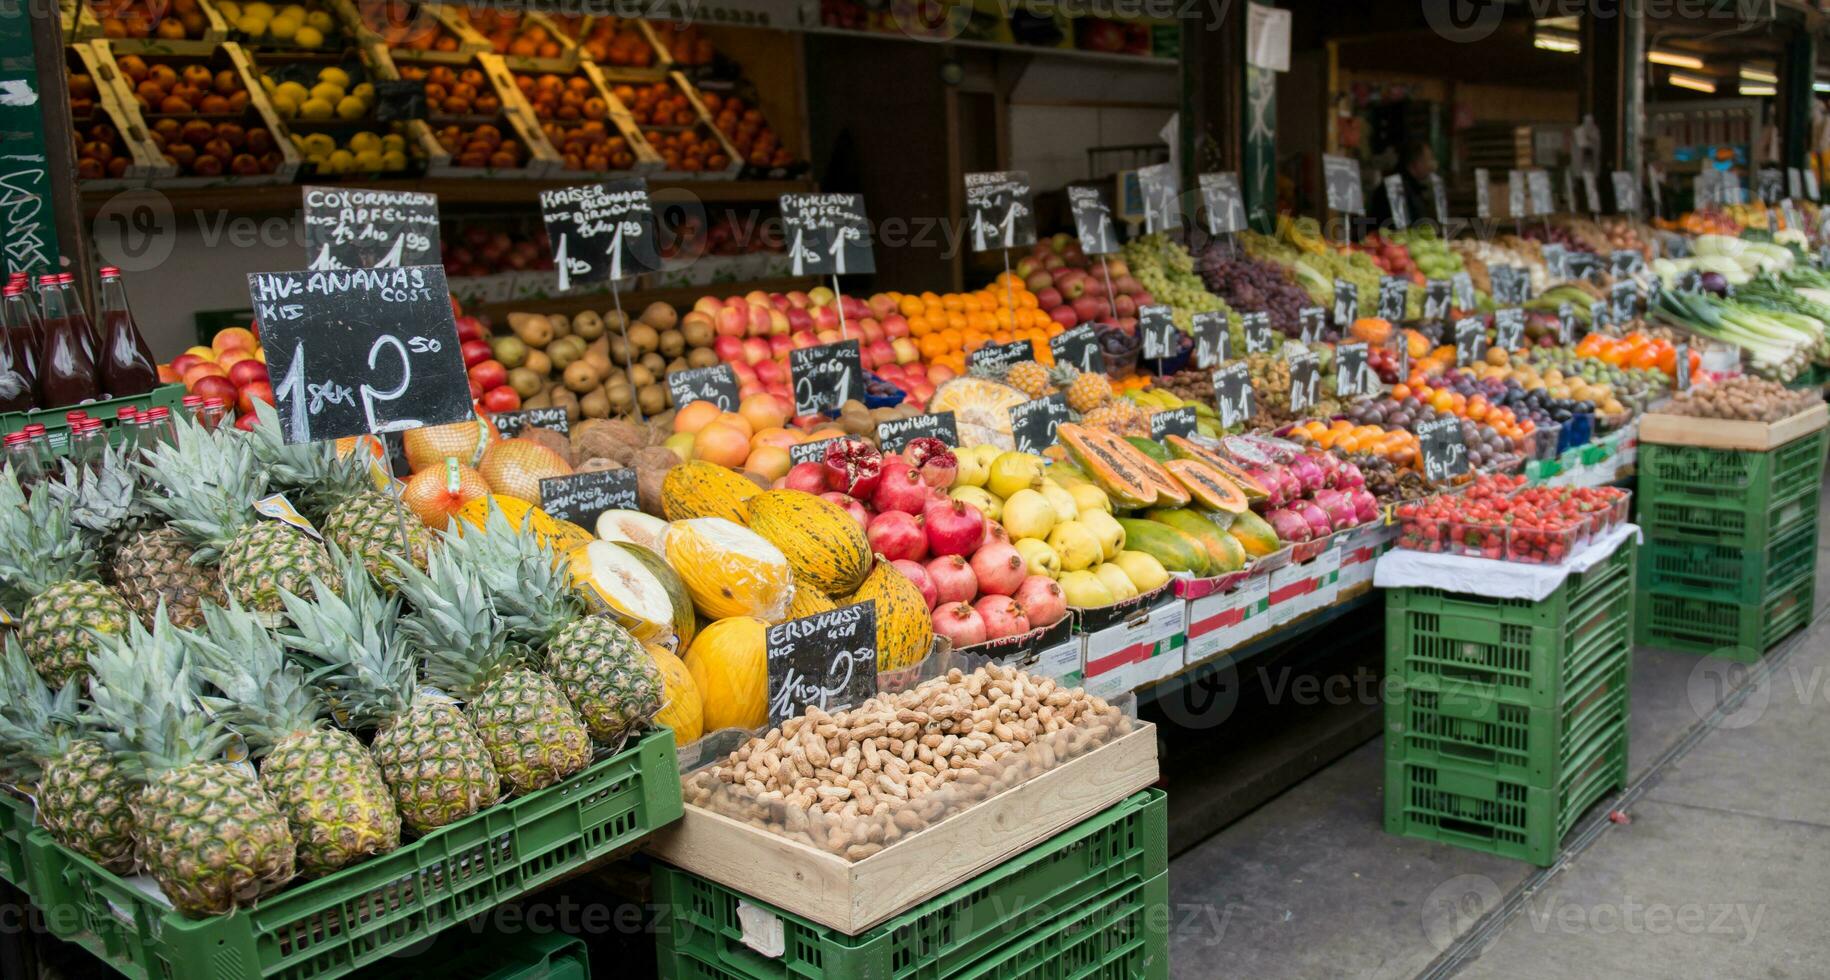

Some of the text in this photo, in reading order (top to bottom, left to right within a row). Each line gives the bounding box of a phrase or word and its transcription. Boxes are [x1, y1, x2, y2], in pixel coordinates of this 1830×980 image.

[406, 232, 431, 252] 99
[605, 221, 622, 280] 1
[380, 287, 433, 302] COST
[275, 339, 311, 444] 1
[360, 334, 424, 435] 2
[407, 336, 442, 353] 50
[769, 605, 863, 646] ERDNUSS
[820, 650, 854, 715] 2
[853, 647, 876, 662] 50
